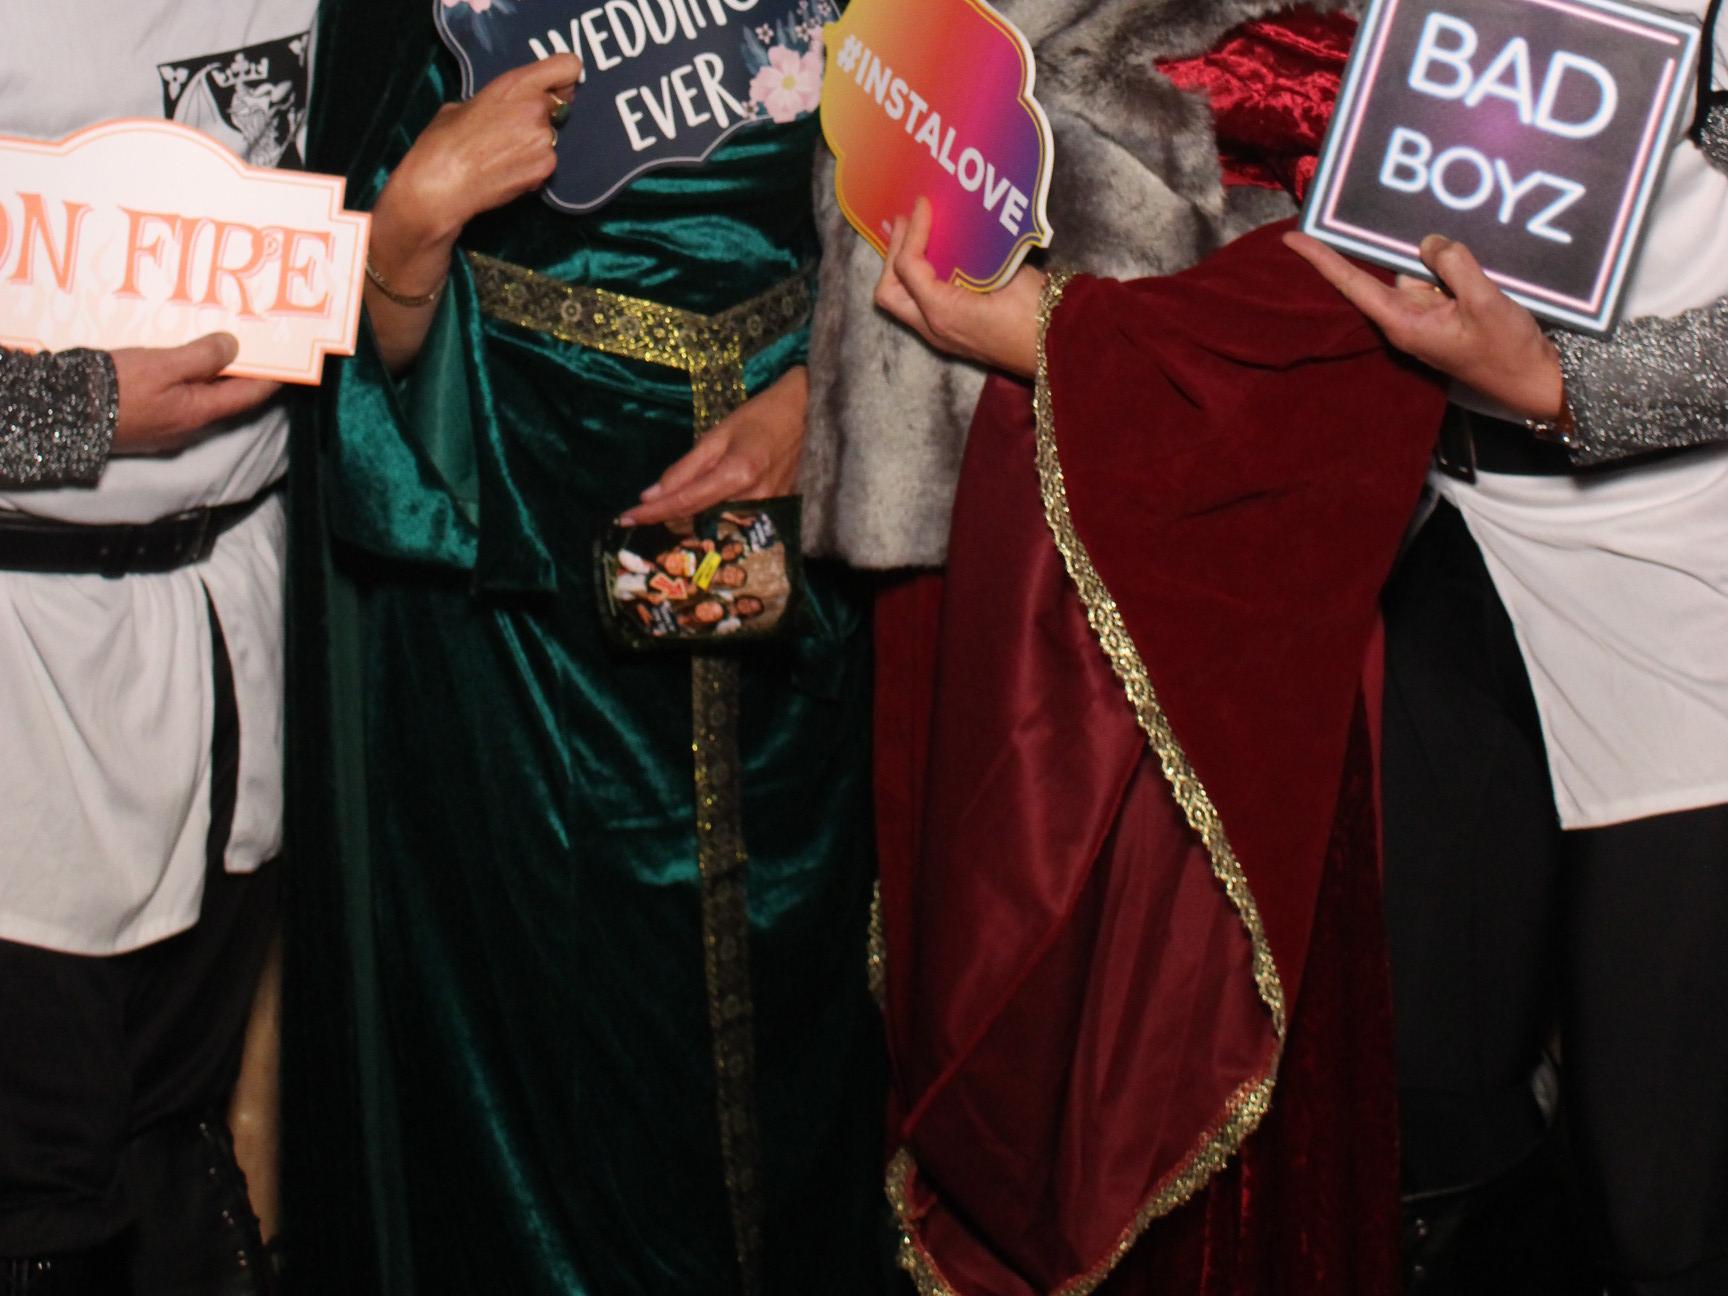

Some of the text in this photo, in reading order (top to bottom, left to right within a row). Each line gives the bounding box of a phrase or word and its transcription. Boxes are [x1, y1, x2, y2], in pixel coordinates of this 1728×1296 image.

[615, 52, 746, 151] EVER
[836, 34, 1029, 236] #INSTALOVE
[1408, 11, 1618, 140] BAD
[1379, 126, 1586, 244] BOYZ
[0, 191, 335, 321] N FIRE
